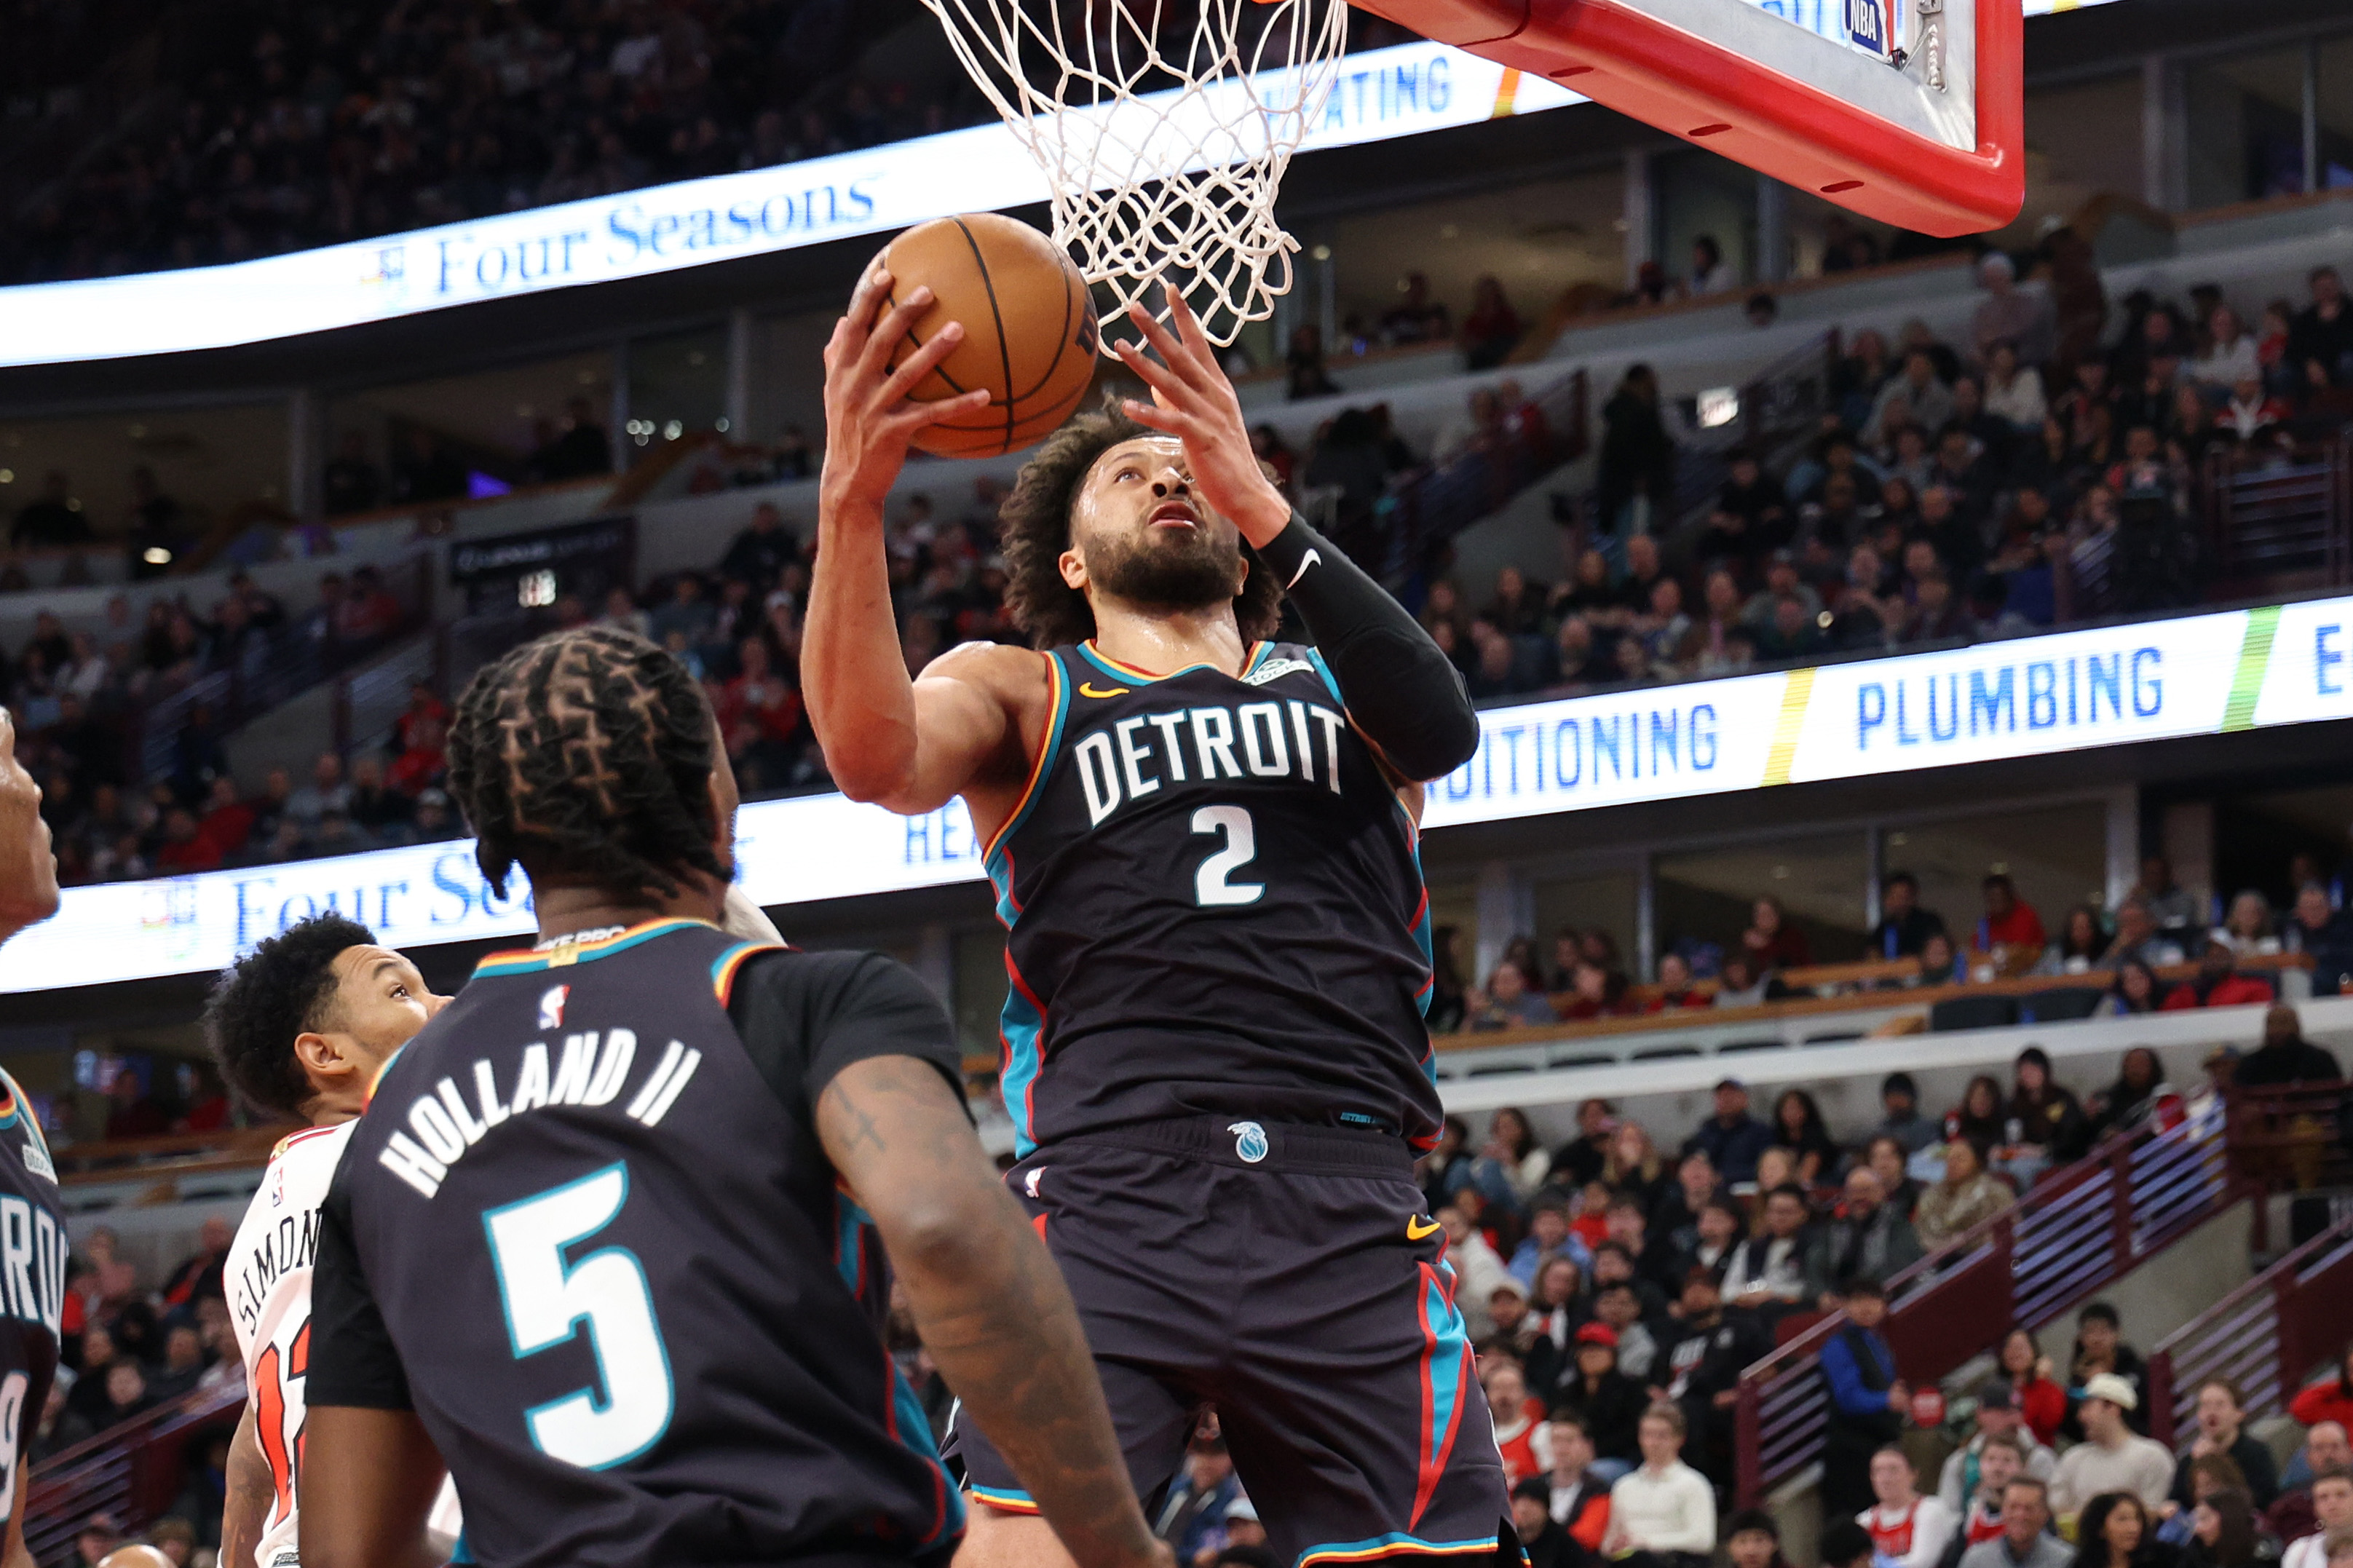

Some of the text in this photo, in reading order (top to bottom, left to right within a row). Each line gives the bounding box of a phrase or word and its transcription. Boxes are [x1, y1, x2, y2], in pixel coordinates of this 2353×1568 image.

[1851, 0, 1877, 41] NBA
[435, 172, 885, 293] Four Seasons
[1857, 646, 2164, 751] PLUMBING
[1073, 700, 1345, 830] DETROIT
[1425, 703, 1717, 803] ITIONING
[1190, 804, 1266, 907] 2
[233, 879, 408, 946] Four
[379, 1028, 702, 1200] HOLLAND II
[481, 1159, 675, 1472] 5
